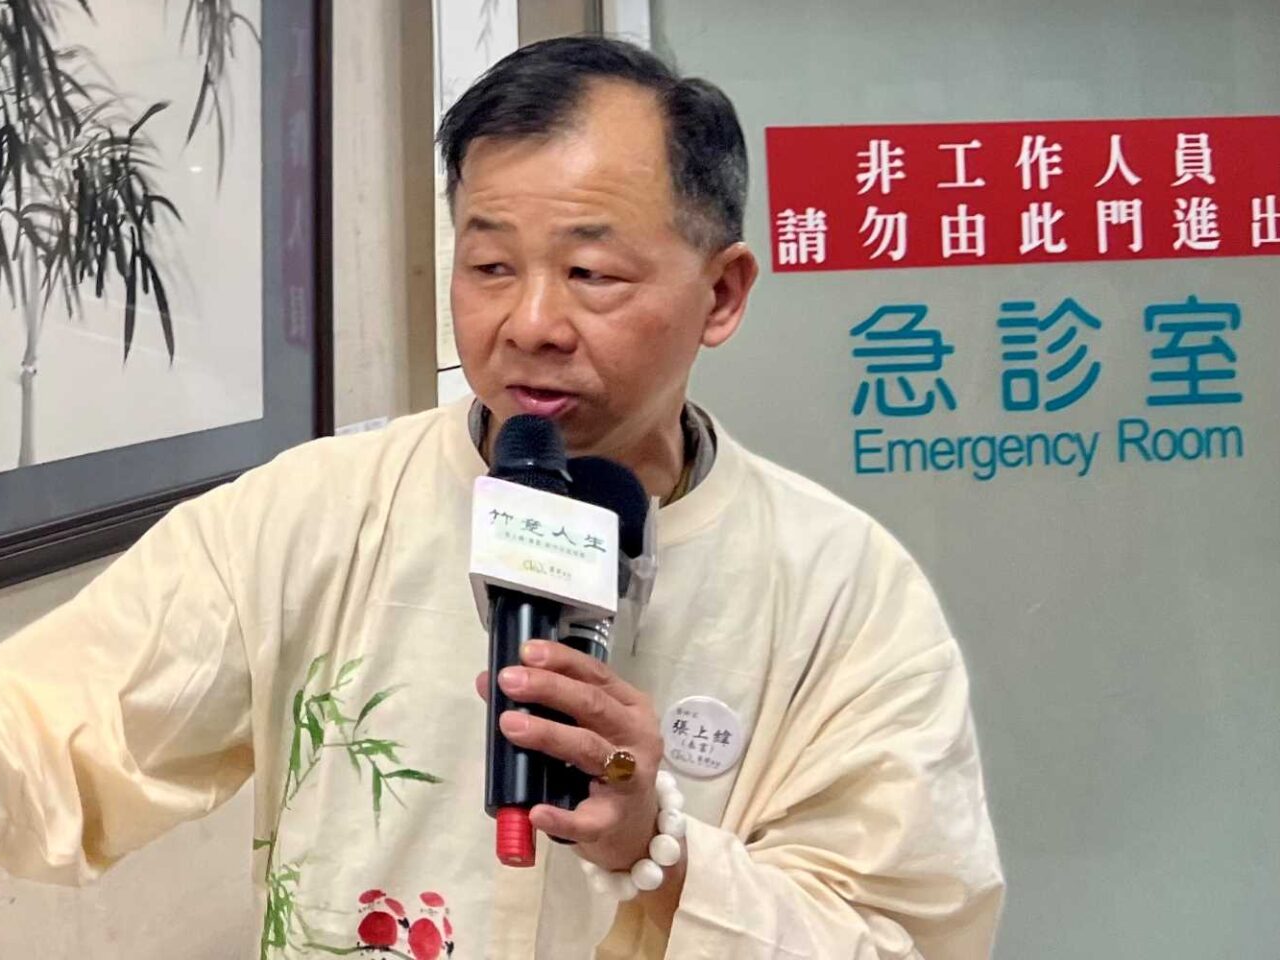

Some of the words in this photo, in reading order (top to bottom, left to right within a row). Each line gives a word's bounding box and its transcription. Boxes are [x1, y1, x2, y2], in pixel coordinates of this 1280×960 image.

[855, 132, 1217, 195] 非工作人員
[776, 194, 1280, 265] 請勿由此門進出
[849, 294, 1244, 417] 急診室
[854, 427, 1100, 482] Emergency
[1119, 417, 1244, 463] Room
